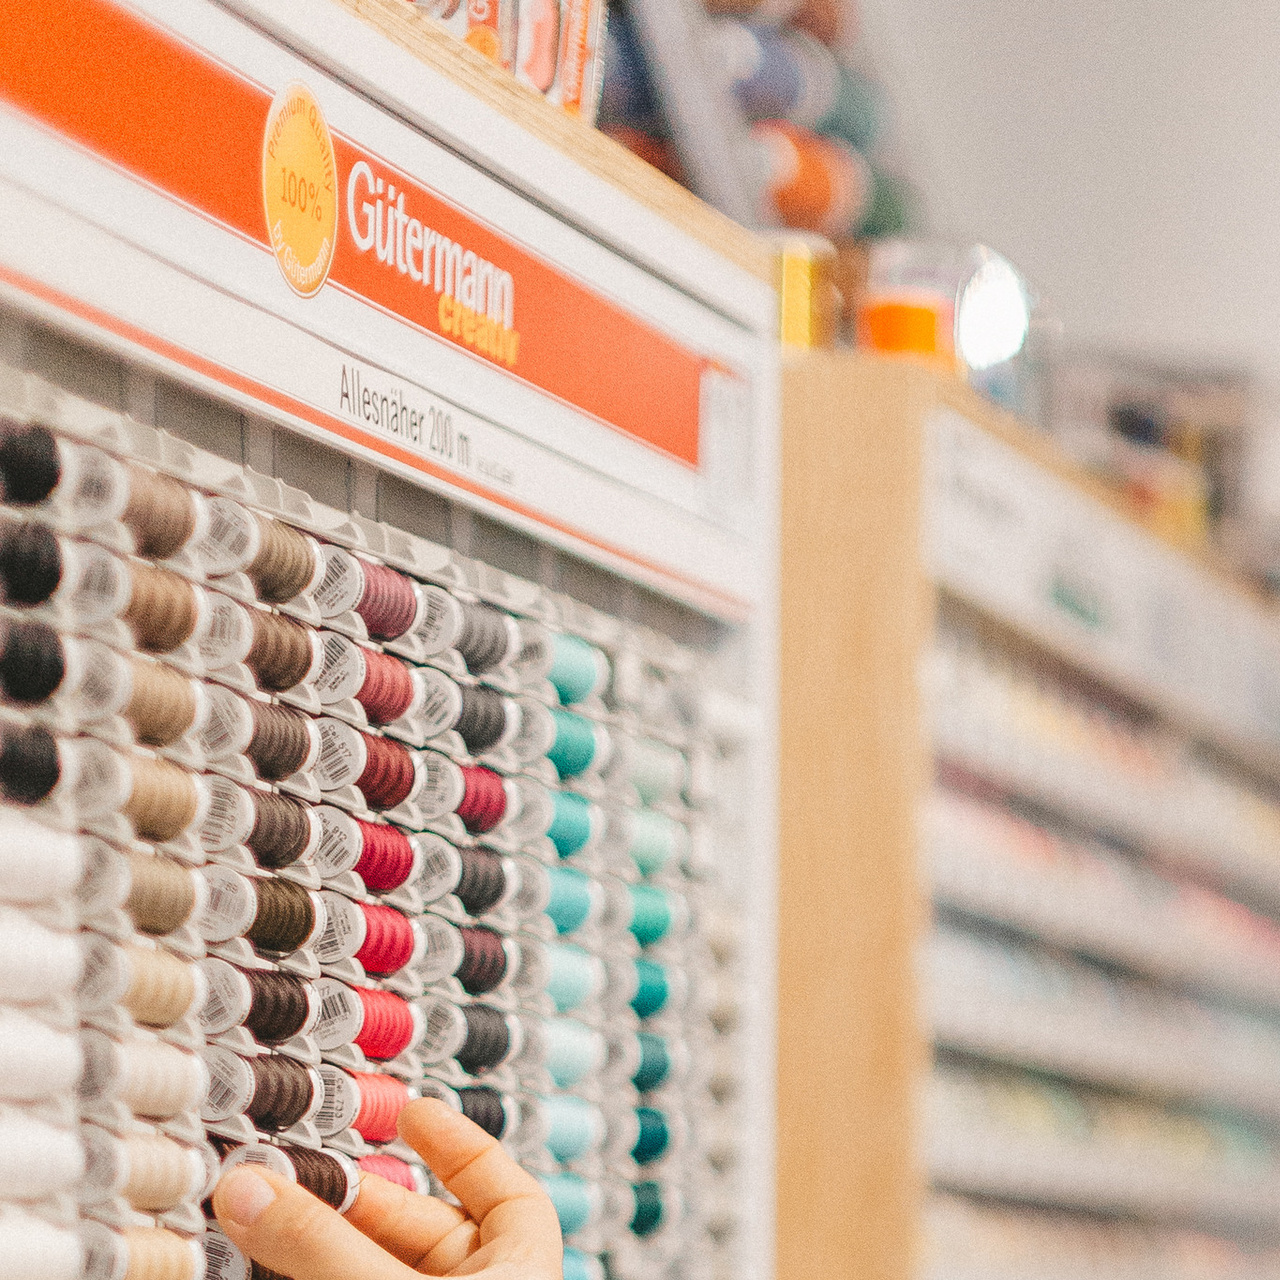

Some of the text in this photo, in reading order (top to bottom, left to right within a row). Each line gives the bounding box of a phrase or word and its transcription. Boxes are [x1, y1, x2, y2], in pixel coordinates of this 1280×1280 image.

[267, 97, 333, 194] Premium Quality
[280, 167, 322, 223] 100%
[347, 160, 514, 331] Gütermann
[340, 363, 470, 469] Allesnäher 200 m
